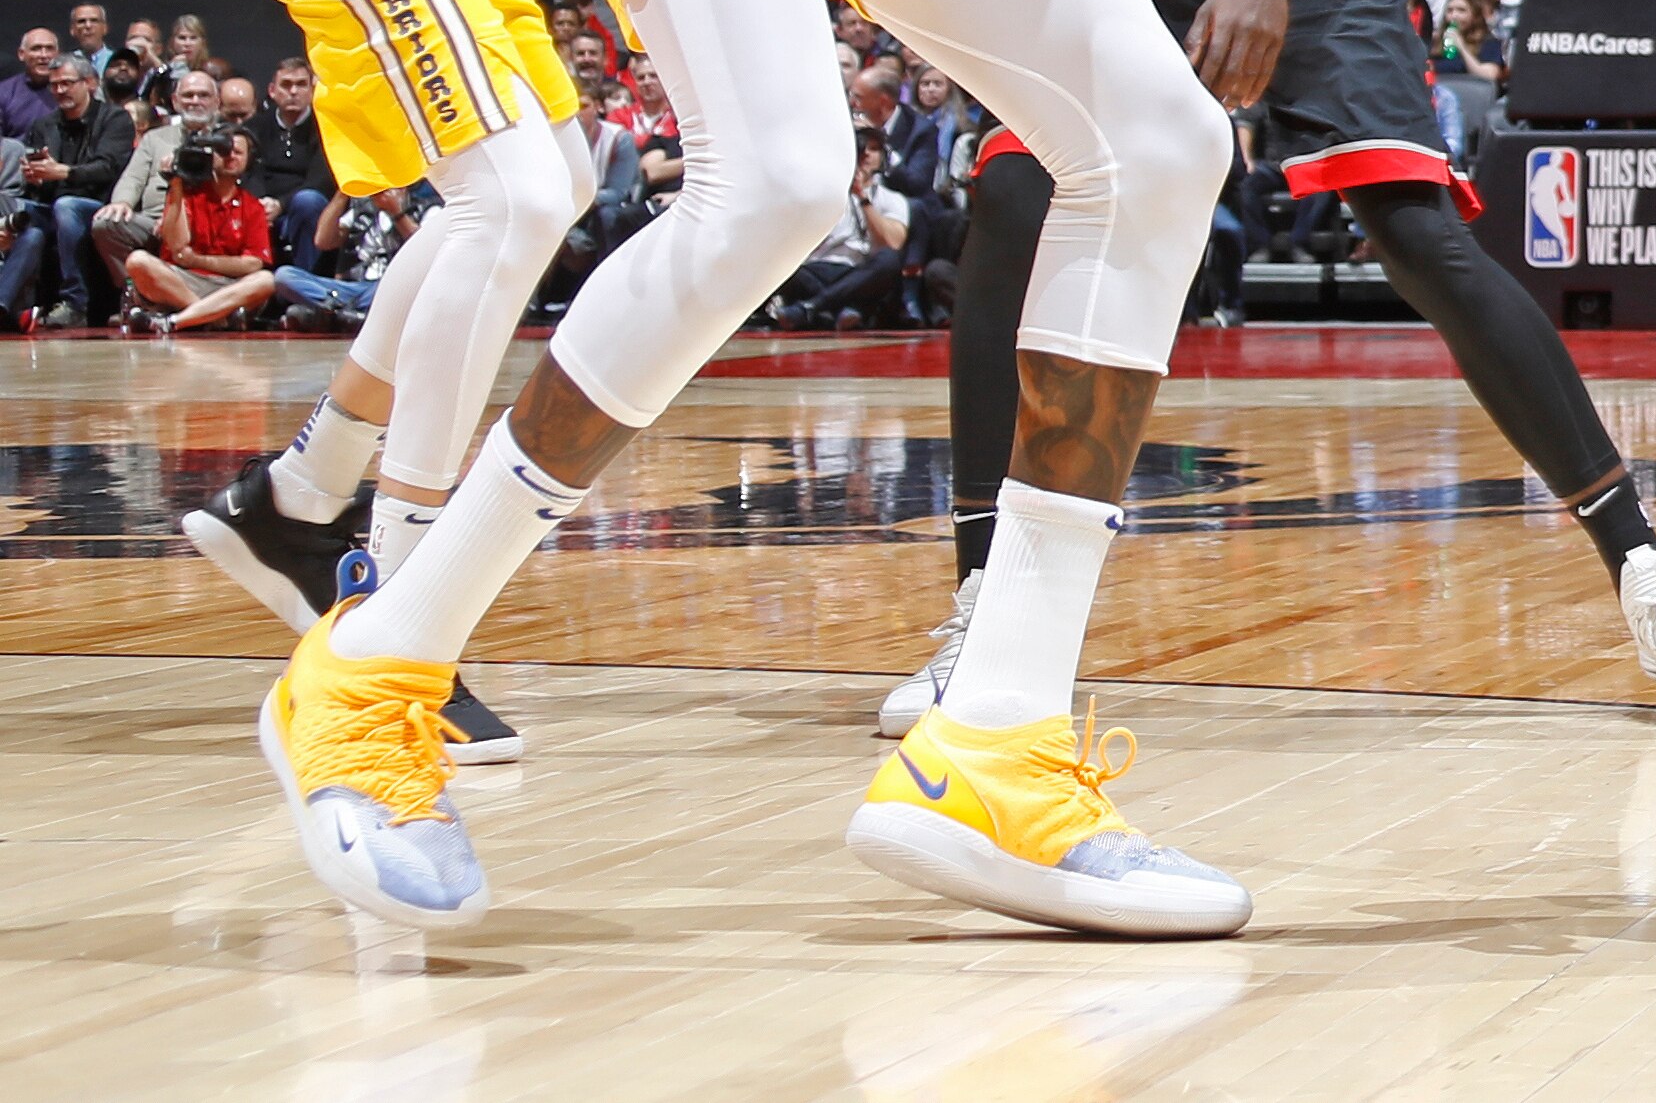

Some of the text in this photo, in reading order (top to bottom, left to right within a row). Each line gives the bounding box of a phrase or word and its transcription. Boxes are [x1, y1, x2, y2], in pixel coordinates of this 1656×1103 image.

[1526, 32, 1655, 56] #NBACares
[1586, 149, 1636, 188] THIS
[1587, 188, 1637, 225] WHY
[1532, 239, 1560, 258] NBA
[1586, 226, 1619, 265] WE
